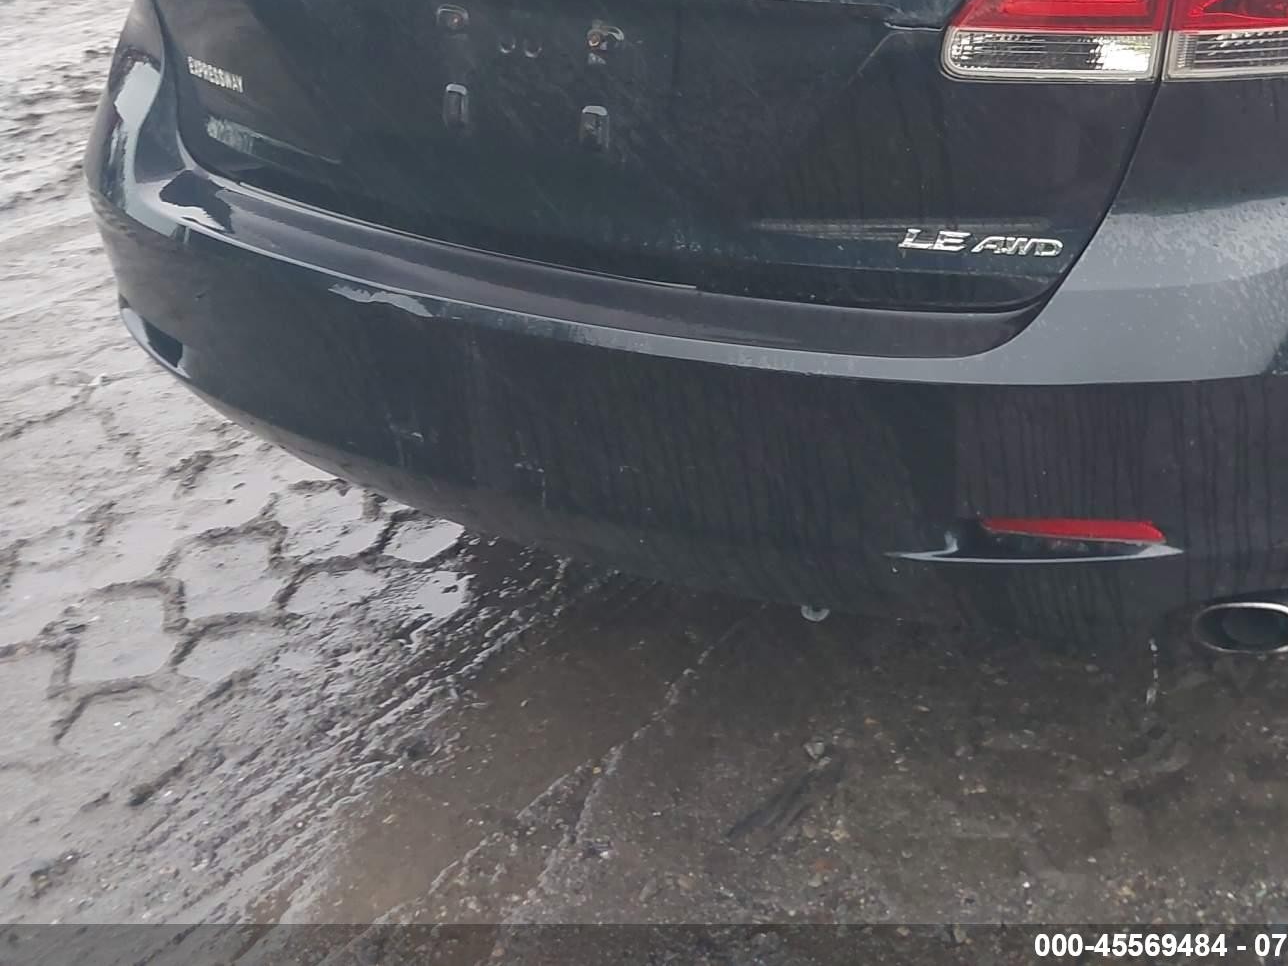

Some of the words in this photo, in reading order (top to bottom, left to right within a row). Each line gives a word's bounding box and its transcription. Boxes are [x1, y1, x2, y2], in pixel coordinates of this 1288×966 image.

[187, 56, 244, 93] EXPRESSWAY
[898, 228, 971, 252] LE
[971, 236, 1064, 257] AWD
